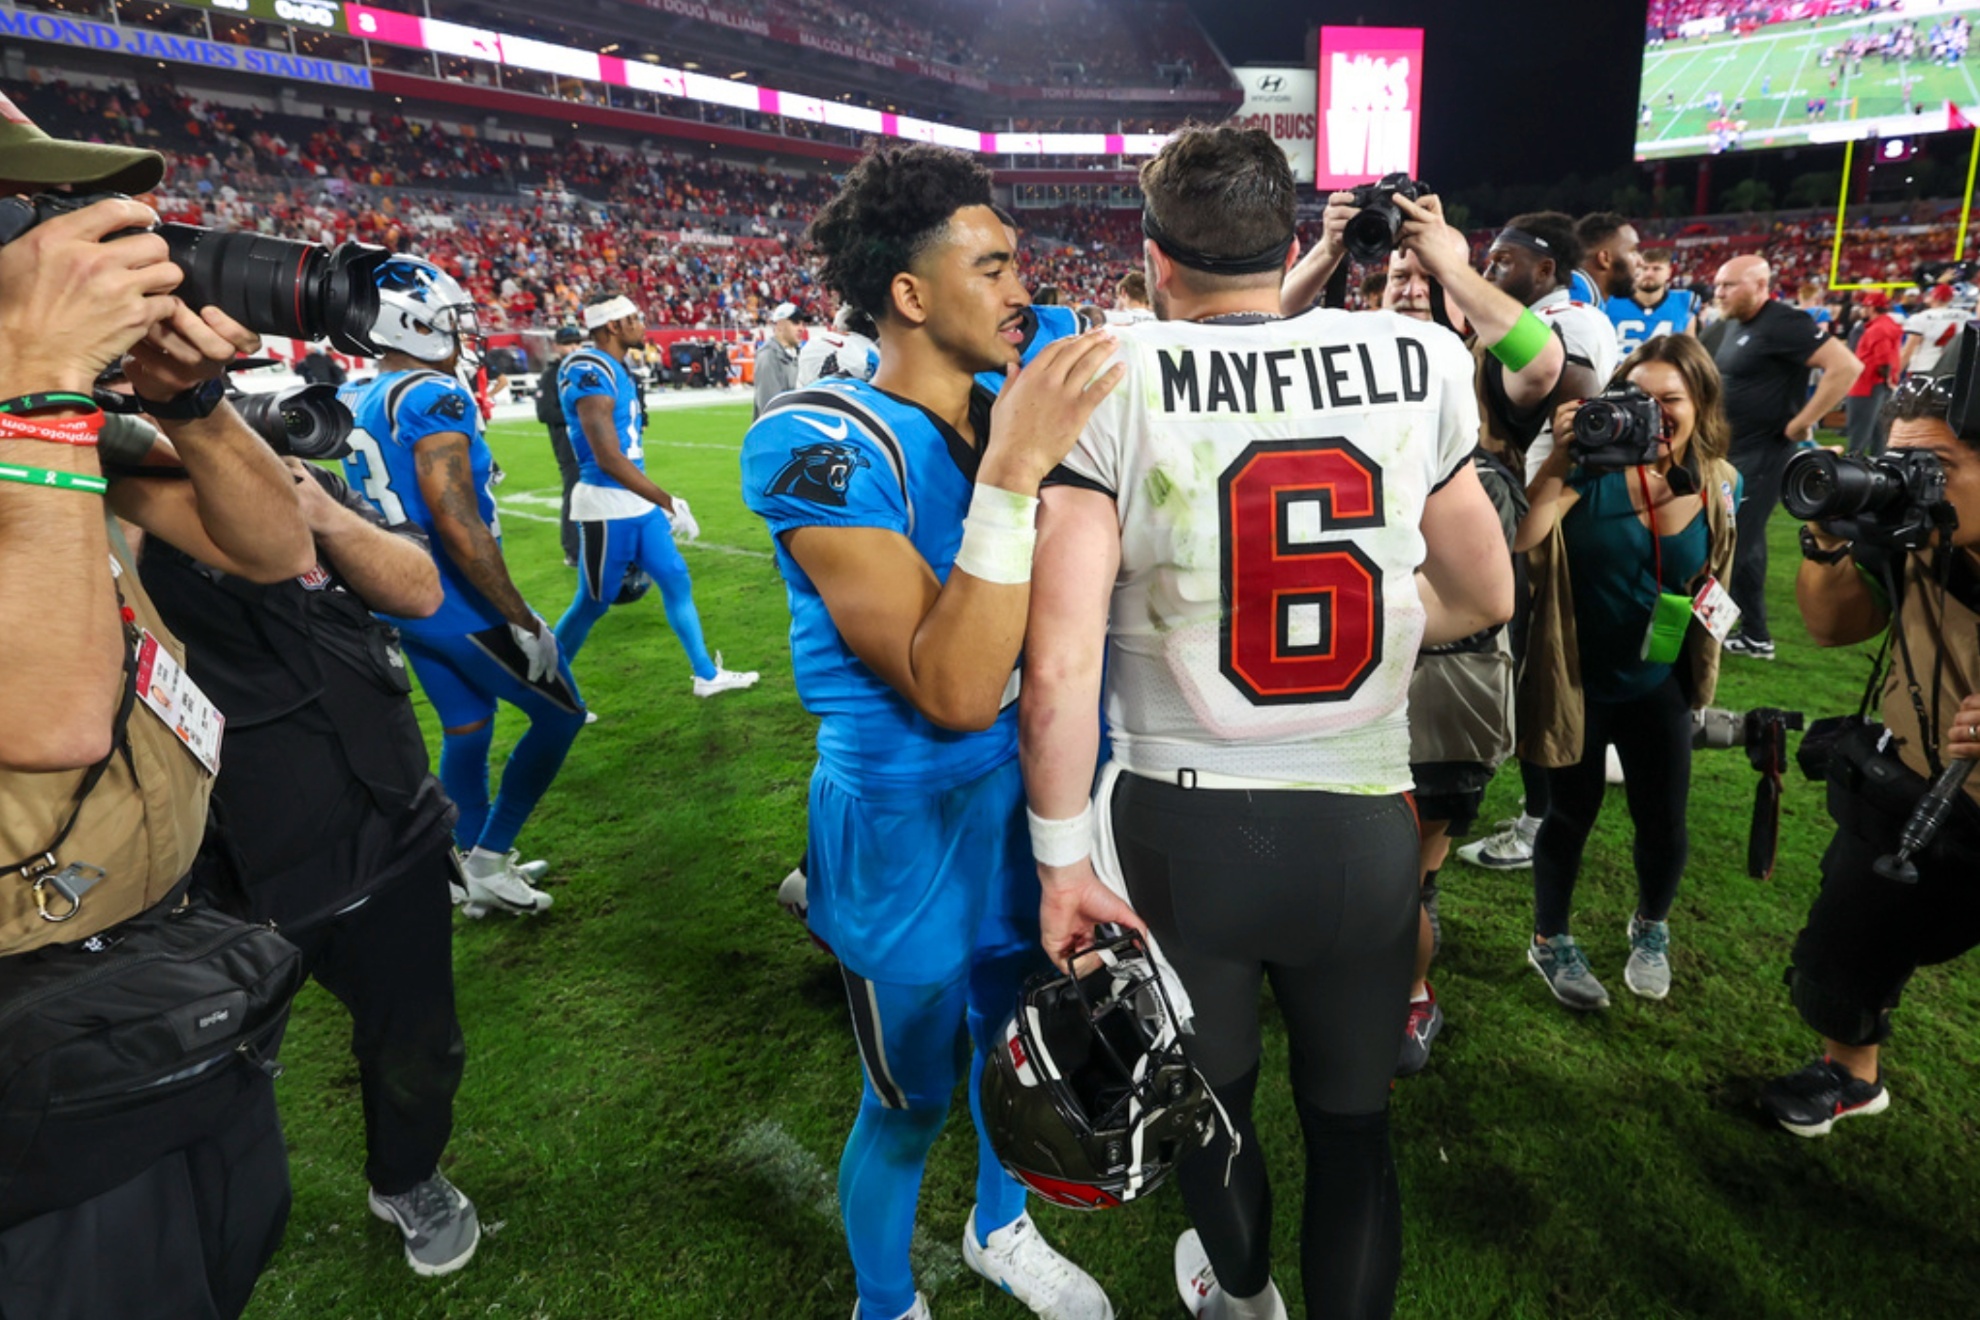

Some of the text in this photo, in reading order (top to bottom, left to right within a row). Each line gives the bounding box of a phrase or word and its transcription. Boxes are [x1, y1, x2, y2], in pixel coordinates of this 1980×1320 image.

[708, 8, 770, 36] WILLIAMS
[126, 31, 238, 68] JAMES
[244, 50, 372, 89] STADIUM
[1250, 94, 1292, 103] HYUNDAI
[1274, 113, 1315, 140] BUCS
[1157, 336, 1429, 413] MAYFIELD
[1217, 436, 1386, 706] 6
